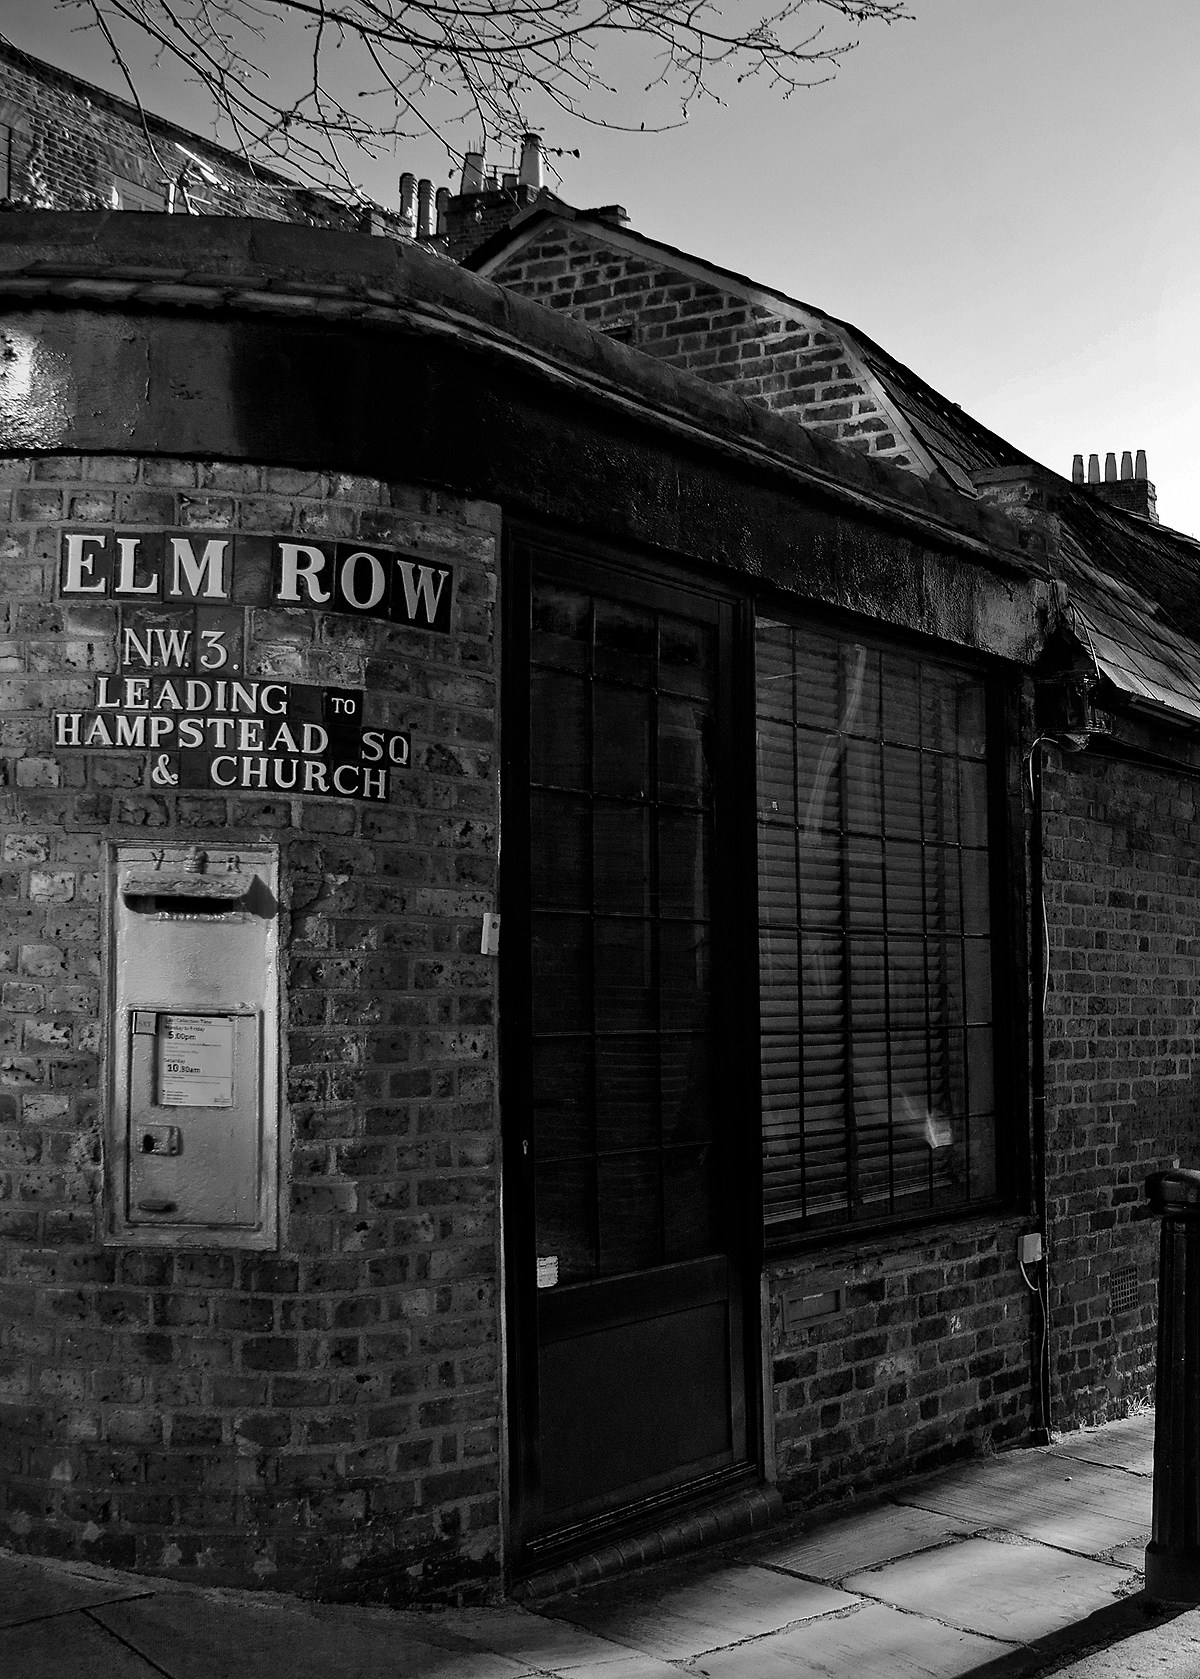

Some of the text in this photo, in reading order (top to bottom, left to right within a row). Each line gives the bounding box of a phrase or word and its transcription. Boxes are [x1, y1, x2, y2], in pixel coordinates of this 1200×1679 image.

[62, 533, 450, 624] ELM ROW
[96, 676, 357, 715] LEADING TO
[54, 713, 410, 765] HAMPSTEAD SQ
[151, 753, 388, 800] & CHURCH
[168, 1030, 197, 1041] 5.00pm
[167, 1063, 201, 1073] 10.30am
